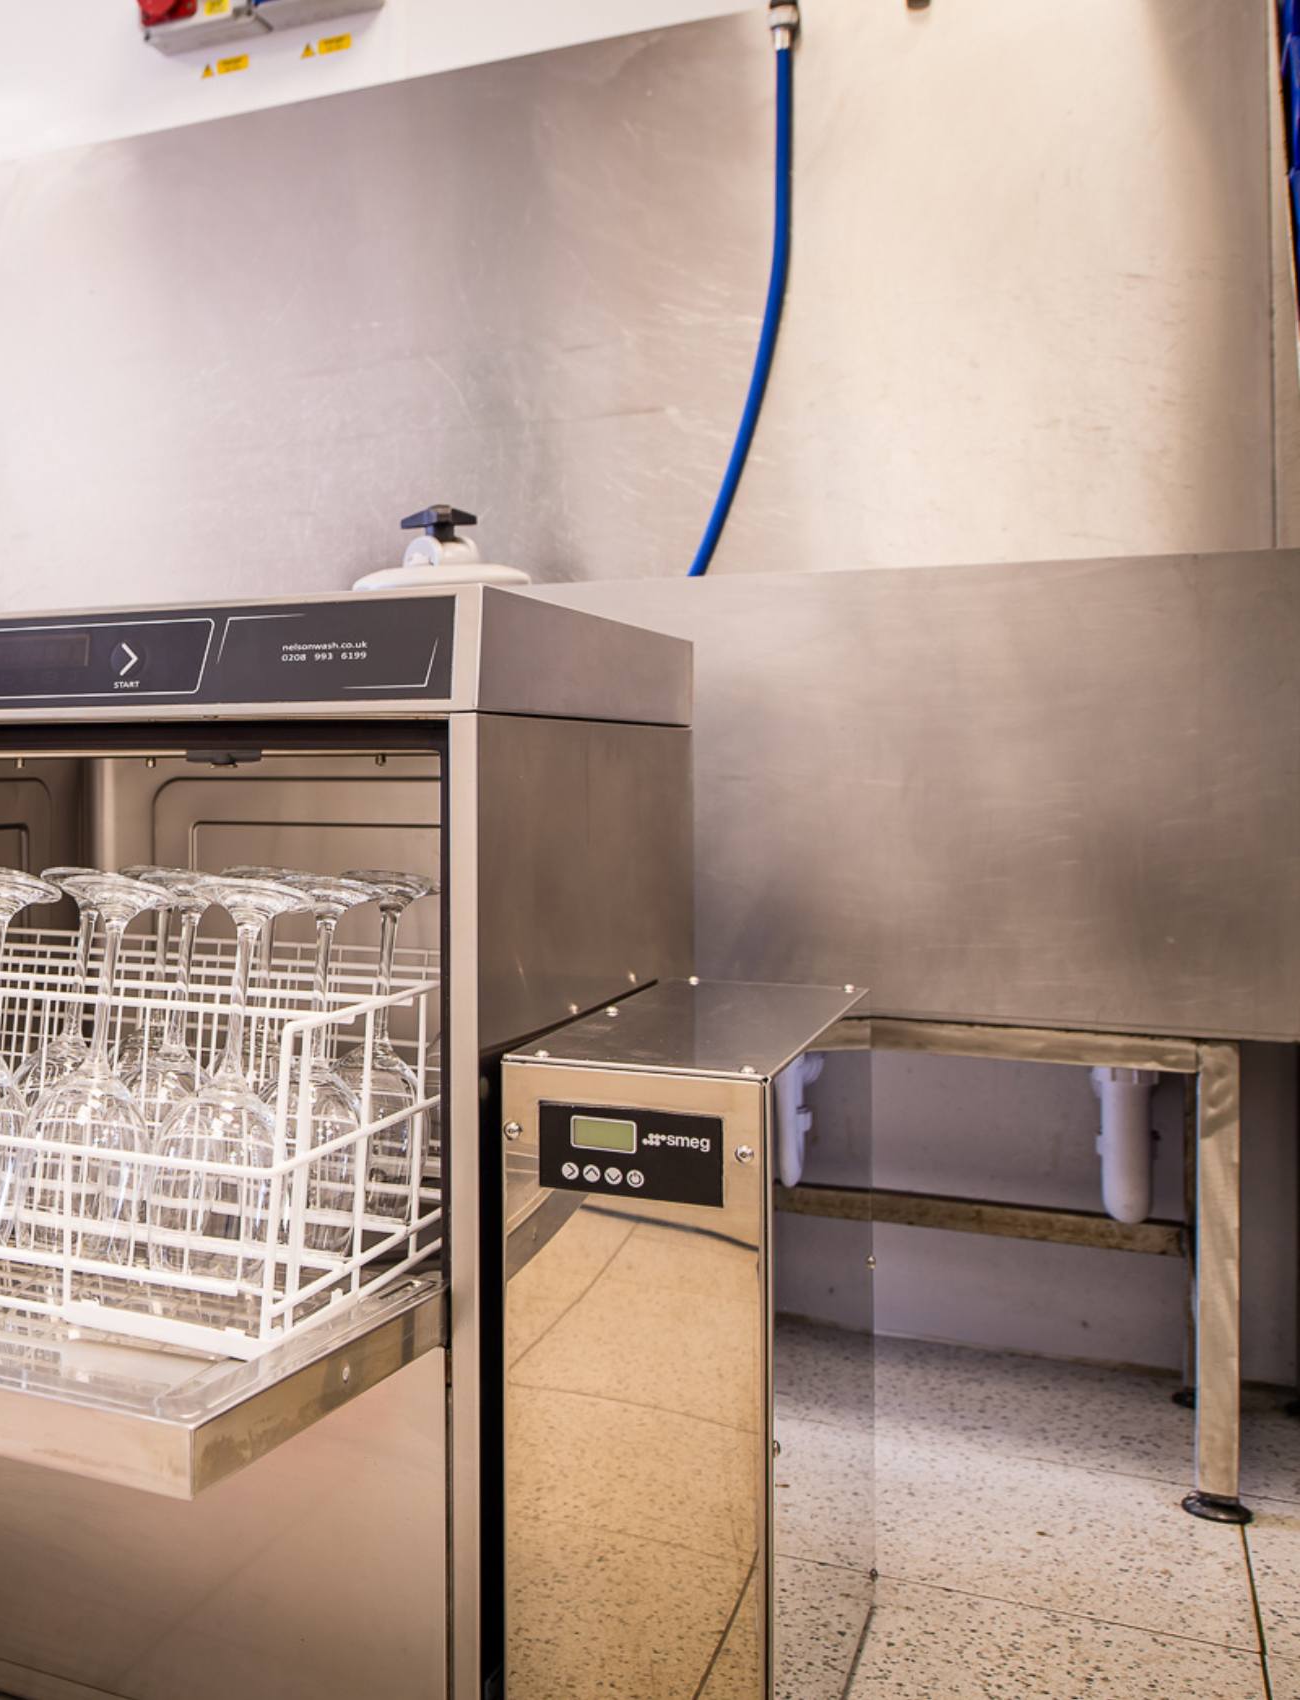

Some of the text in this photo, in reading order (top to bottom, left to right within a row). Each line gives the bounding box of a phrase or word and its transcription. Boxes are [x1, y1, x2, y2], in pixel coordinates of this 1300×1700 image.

[282, 641, 367, 651] nelsonwash.co.uk
[281, 650, 367, 661] 0208 993 6199
[113, 680, 140, 689] START
[666, 1134, 711, 1153] smeg
